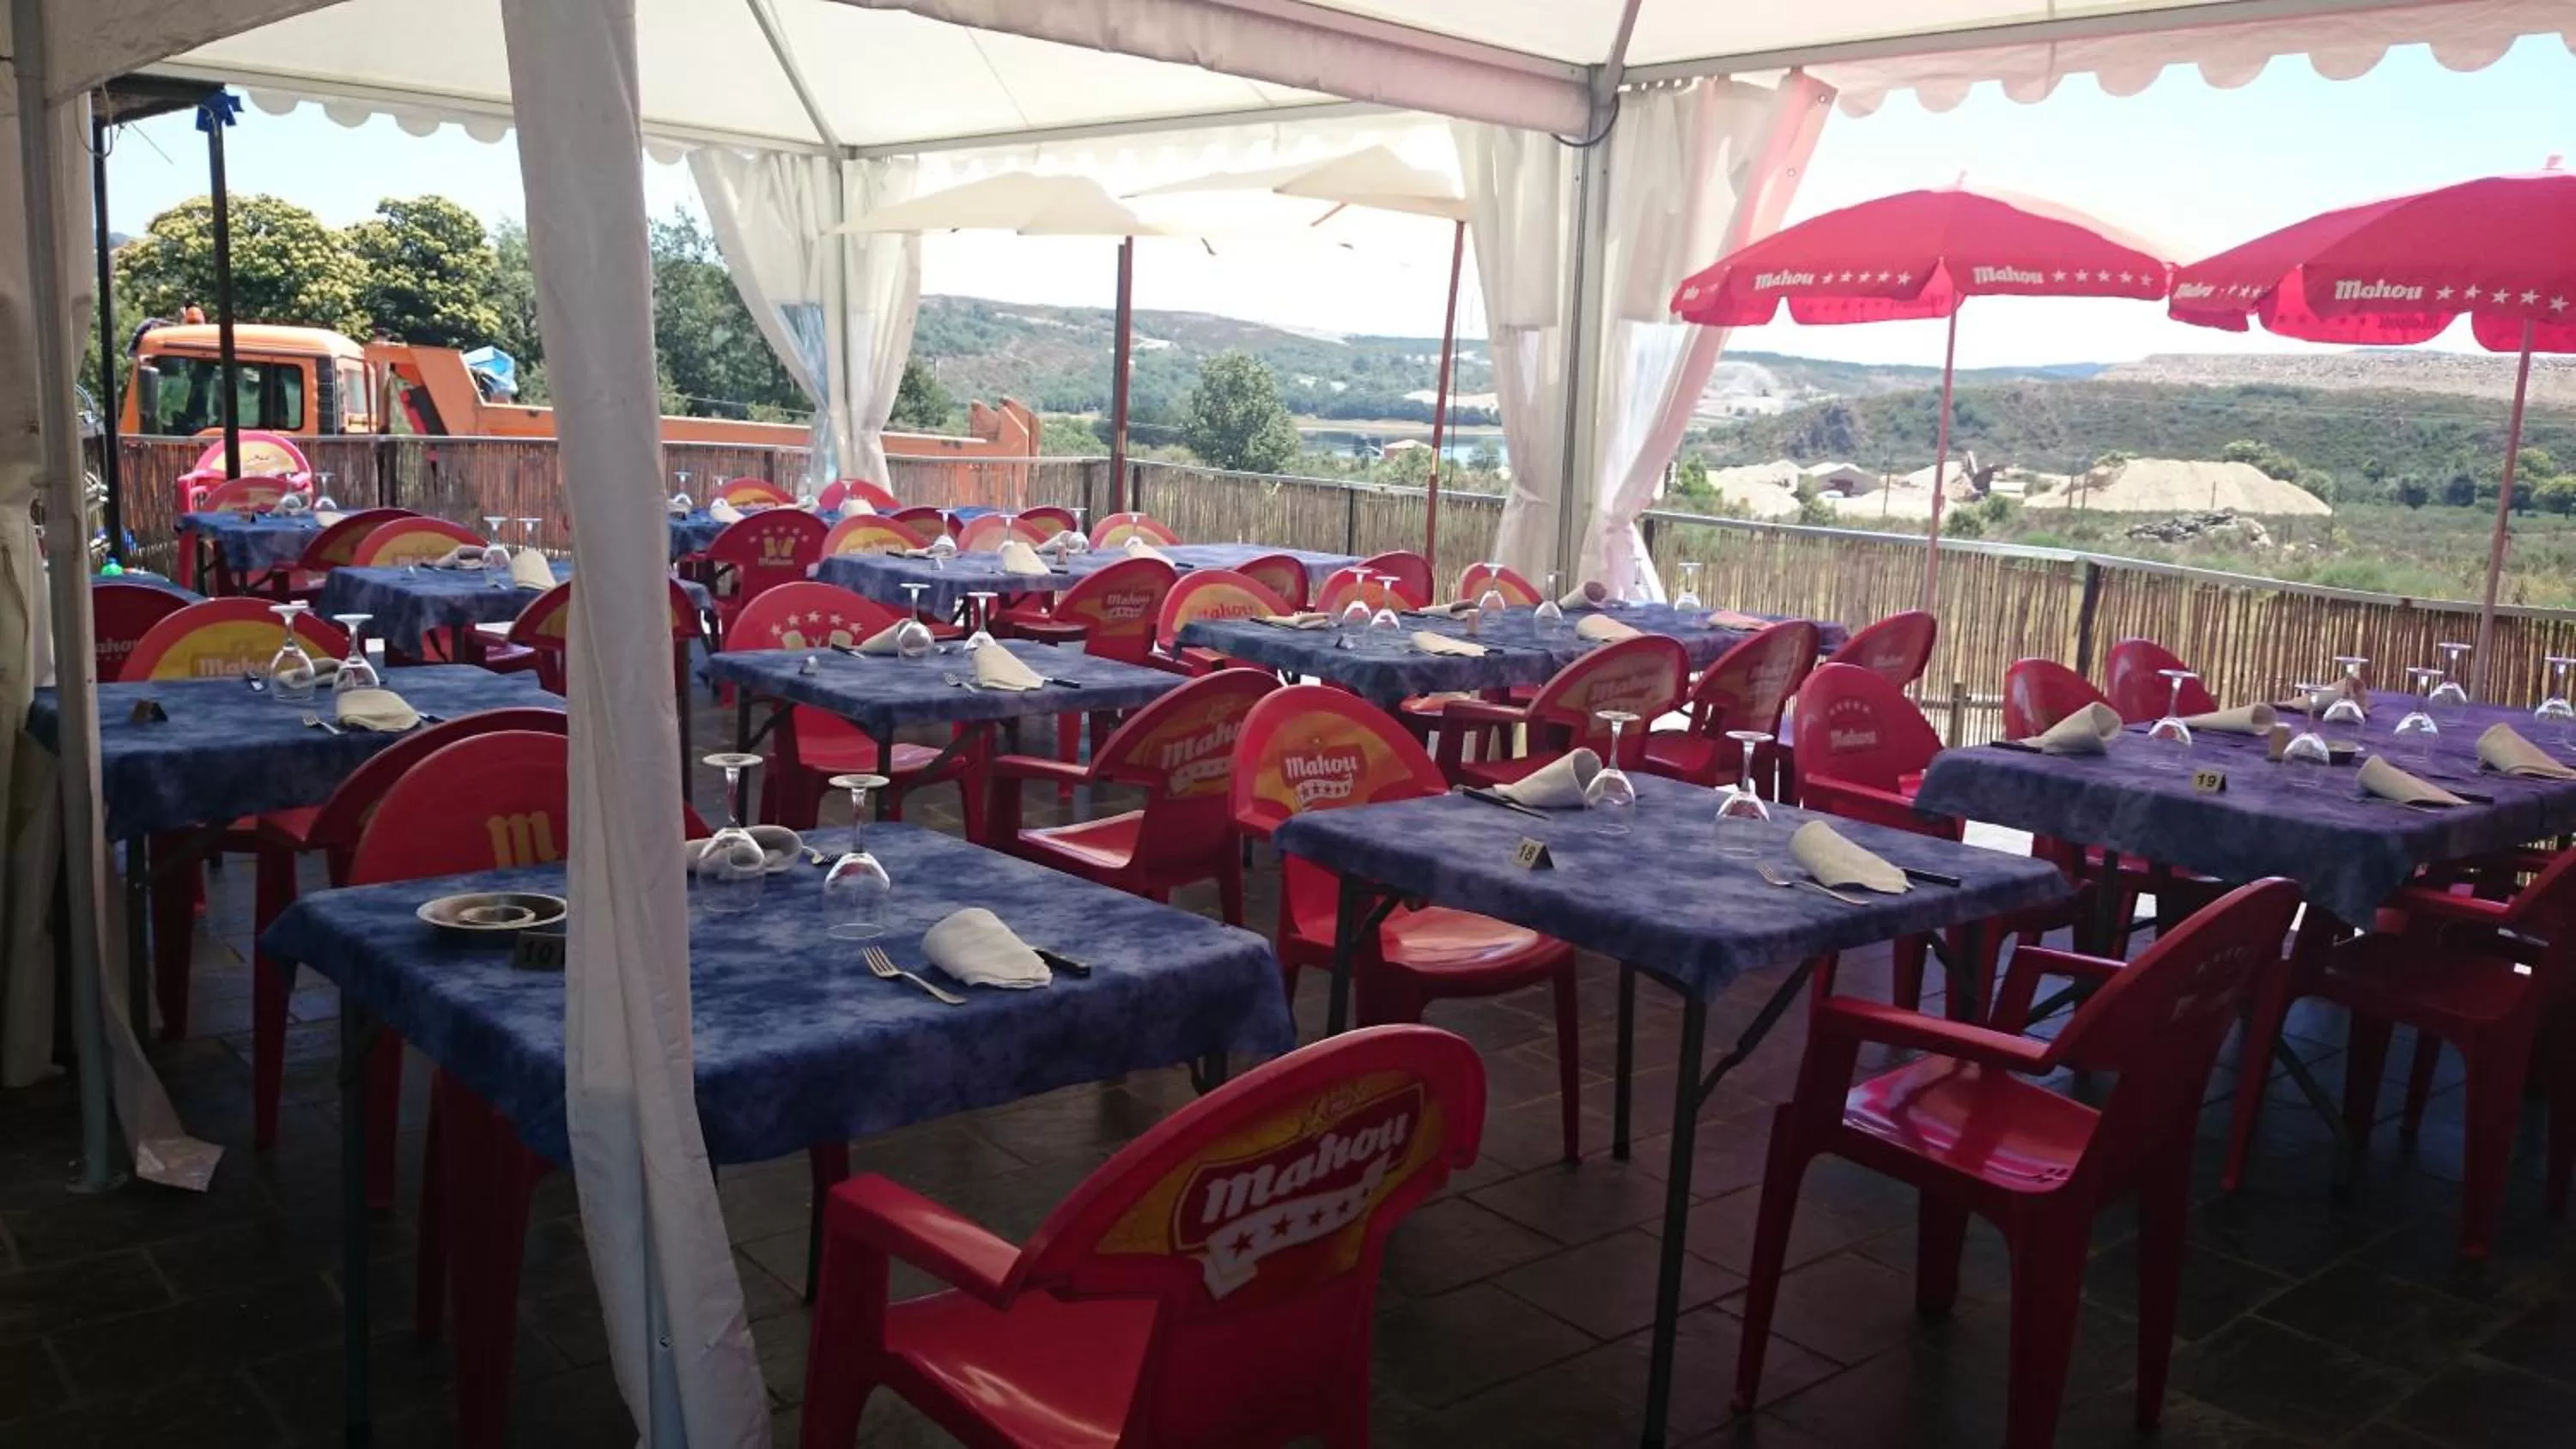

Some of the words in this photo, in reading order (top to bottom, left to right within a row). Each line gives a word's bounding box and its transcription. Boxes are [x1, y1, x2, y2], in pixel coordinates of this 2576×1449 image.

[1754, 269, 1815, 289] Mahou
[1972, 265, 2044, 283] Mahou
[2335, 278, 2424, 300] Mahou
[1285, 755, 1358, 779] Mahou
[2196, 773, 2217, 787] 19
[1519, 844, 1536, 861] 18
[1201, 1113, 1410, 1224] Mahou
